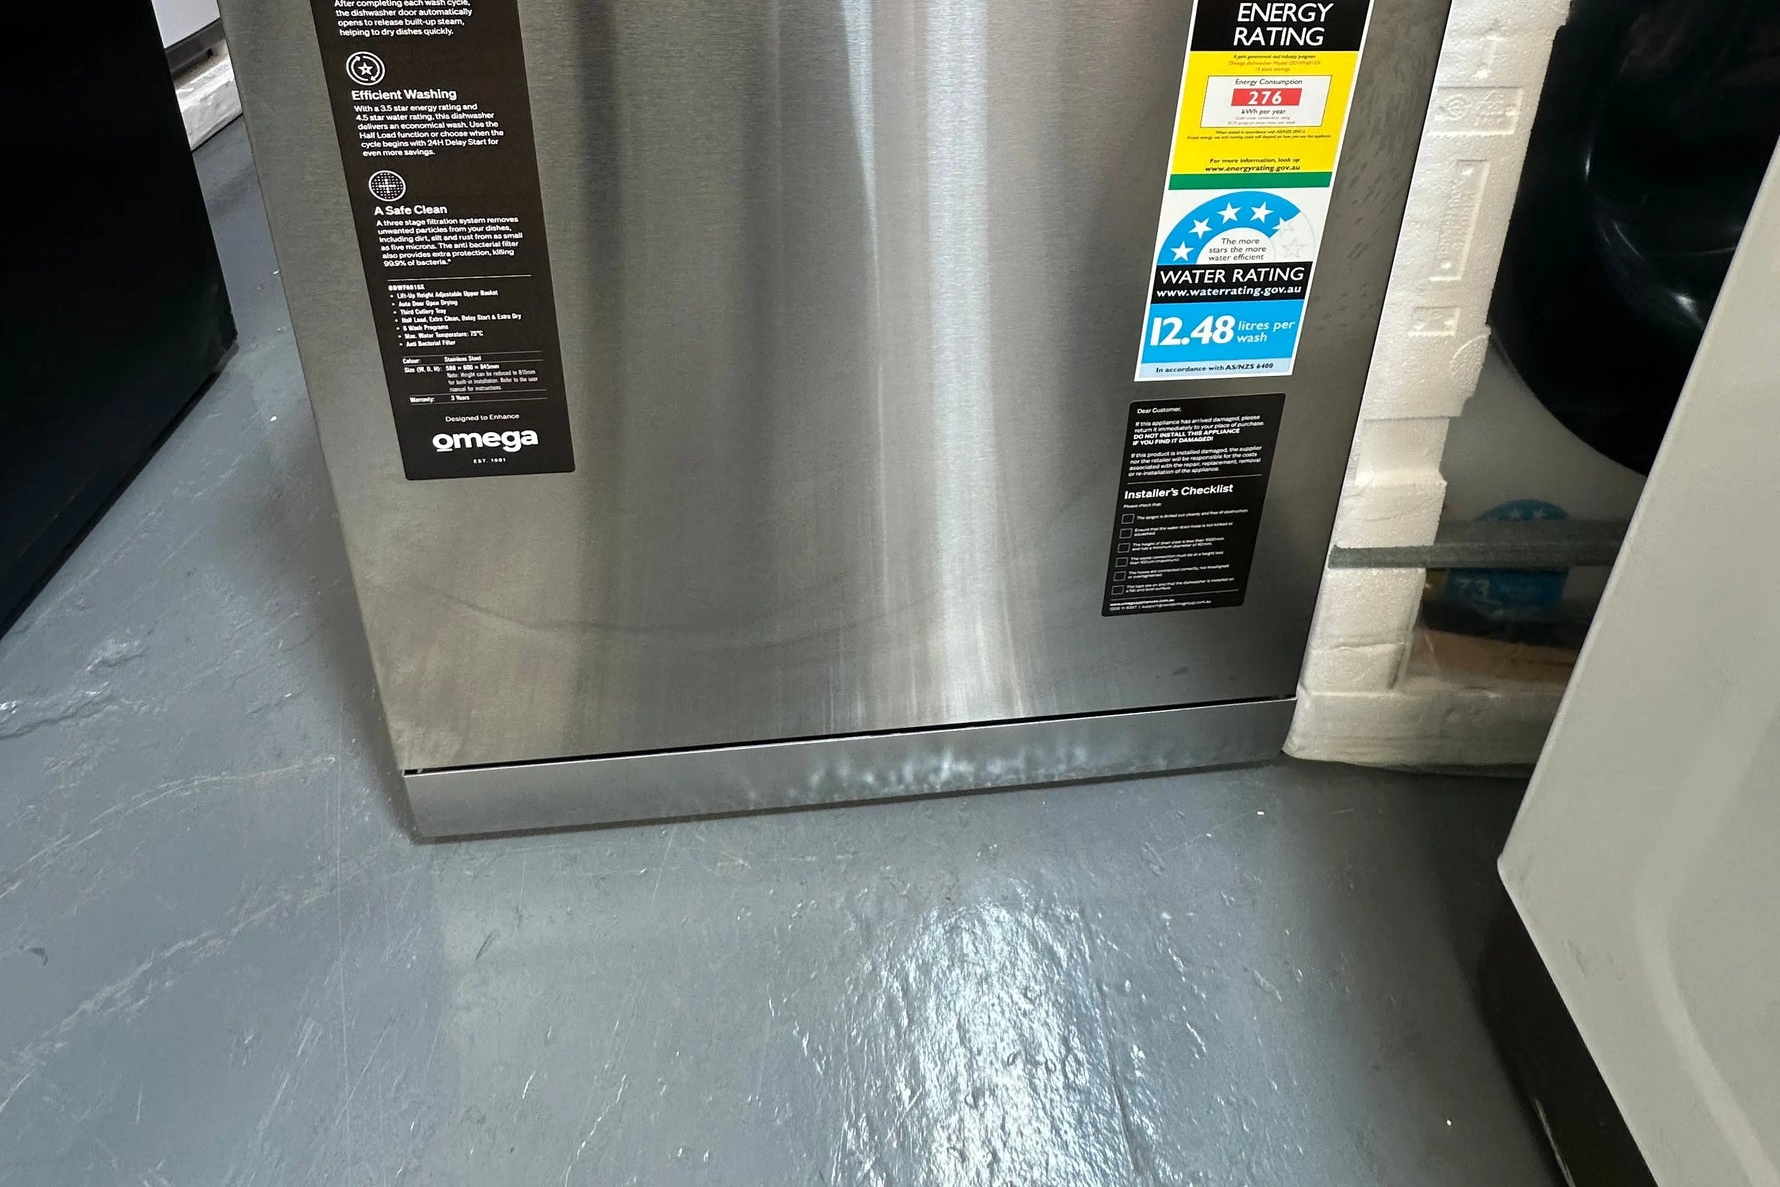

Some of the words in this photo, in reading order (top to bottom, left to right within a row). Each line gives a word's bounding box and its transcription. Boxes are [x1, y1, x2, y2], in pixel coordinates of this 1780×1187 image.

[334, 0, 355, 7] After
[356, 0, 402, 8] completing
[351, 8, 396, 16] dishwasher
[398, 8, 417, 16] door
[418, 8, 472, 18] automatically
[1237, 3, 1334, 22] ENERGY
[338, 20, 363, 28] opens
[405, 18, 436, 27] built-up
[437, 17, 465, 26] steam,
[340, 28, 370, 37] helping
[381, 28, 395, 37] dry
[396, 27, 423, 35] dishes
[423, 27, 454, 37] quickly.
[1233, 27, 1324, 46] RATING
[1235, 78, 1257, 87] Energy
[1259, 78, 1303, 87] Consumption
[351, 90, 402, 101] Efficient
[404, 89, 457, 102] Washing
[1248, 91, 1282, 105] 276
[438, 104, 461, 113] rating
[409, 113, 434, 122] rating,
[358, 122, 388, 130] delivers
[400, 121, 445, 129] economical
[404, 148, 435, 157] savings.
[374, 206, 384, 216] A
[385, 205, 412, 215] Safe
[413, 205, 448, 215] Clean
[1221, 237, 1236, 245] The
[1160, 270, 1225, 284] WATER
[1232, 267, 1305, 282] RATING
[1156, 286, 1301, 297] www.waterrating.gov.au
[1150, 315, 1235, 346] 12.48
[1238, 321, 1270, 330] litres
[1273, 321, 1295, 334] per
[1237, 332, 1267, 343] wash
[1164, 365, 1207, 373] accordance
[1152, 406, 1182, 414] Customer,
[445, 413, 479, 424] Designed
[480, 413, 488, 421] to
[489, 412, 520, 420] Enhance
[1203, 428, 1240, 436] APPLIANCE
[432, 429, 538, 452] omega
[1181, 483, 1234, 496] Checklist
